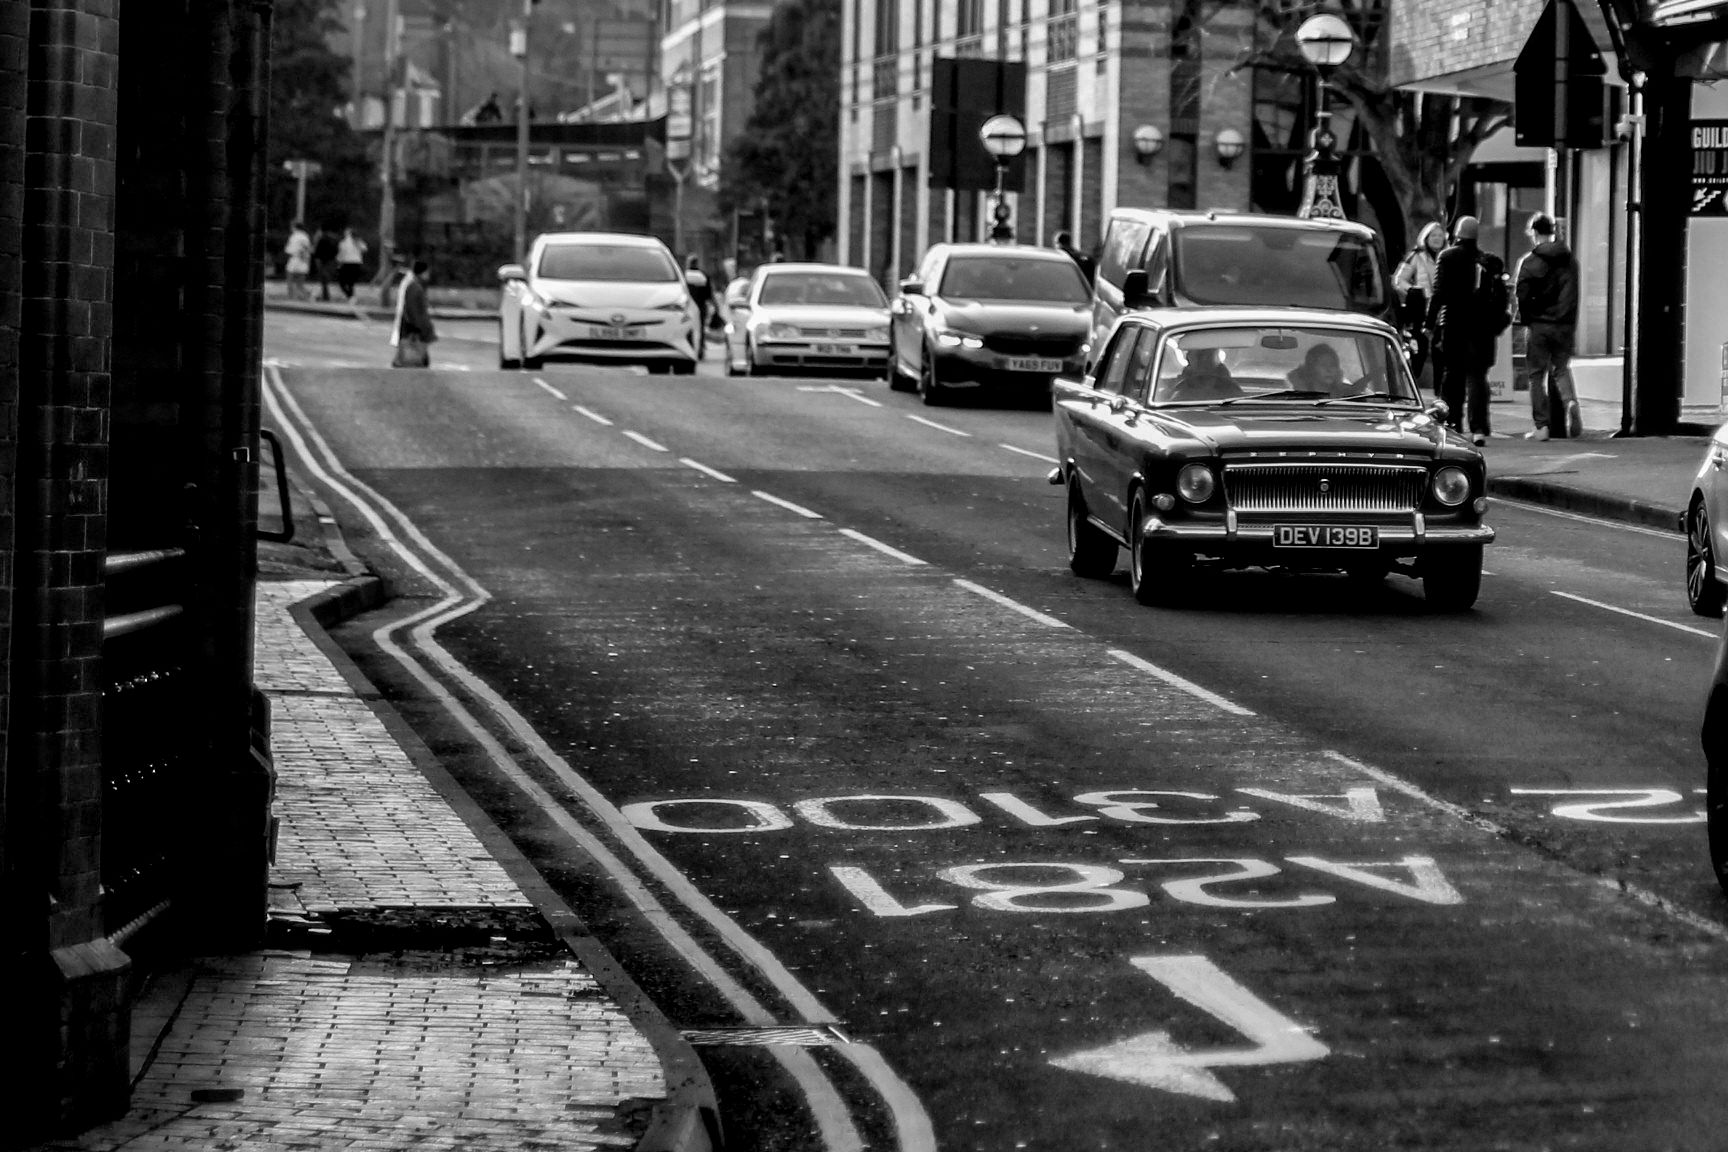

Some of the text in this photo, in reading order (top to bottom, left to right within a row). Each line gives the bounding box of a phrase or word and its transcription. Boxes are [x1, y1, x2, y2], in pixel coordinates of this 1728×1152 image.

[1692, 150, 1716, 175] JIU
[1280, 527, 1373, 546] DEV 139B
[620, 788, 1386, 834] A3100
[829, 854, 1466, 918] A281
